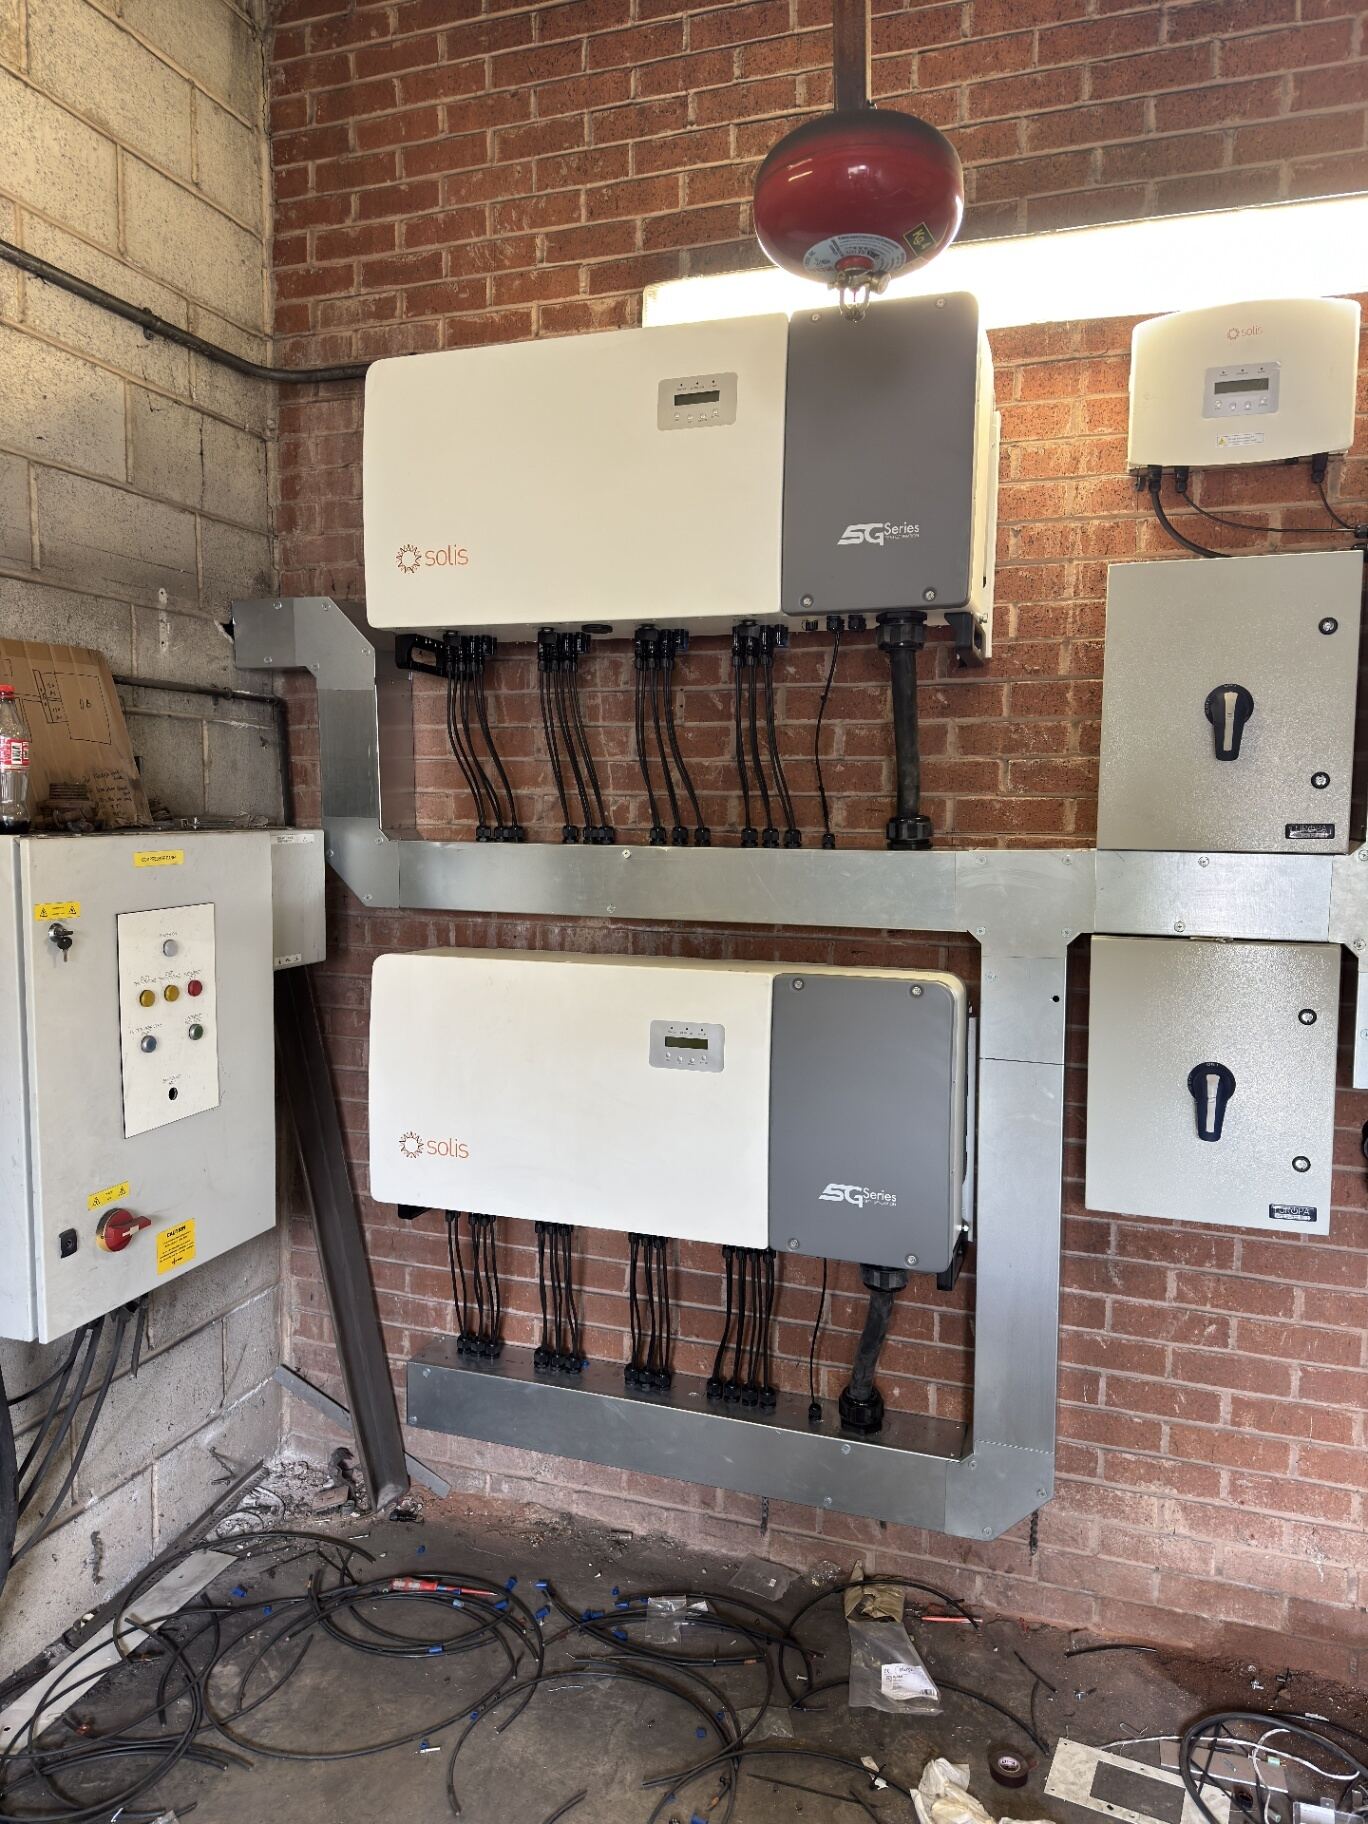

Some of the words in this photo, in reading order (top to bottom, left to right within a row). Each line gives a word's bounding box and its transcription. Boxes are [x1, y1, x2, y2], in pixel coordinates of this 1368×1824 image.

[1241, 325, 1264, 337] solis
[884, 522, 920, 536] Series
[425, 544, 469, 566] solis
[427, 1138, 470, 1159] solis
[863, 1187, 897, 1203] Series
